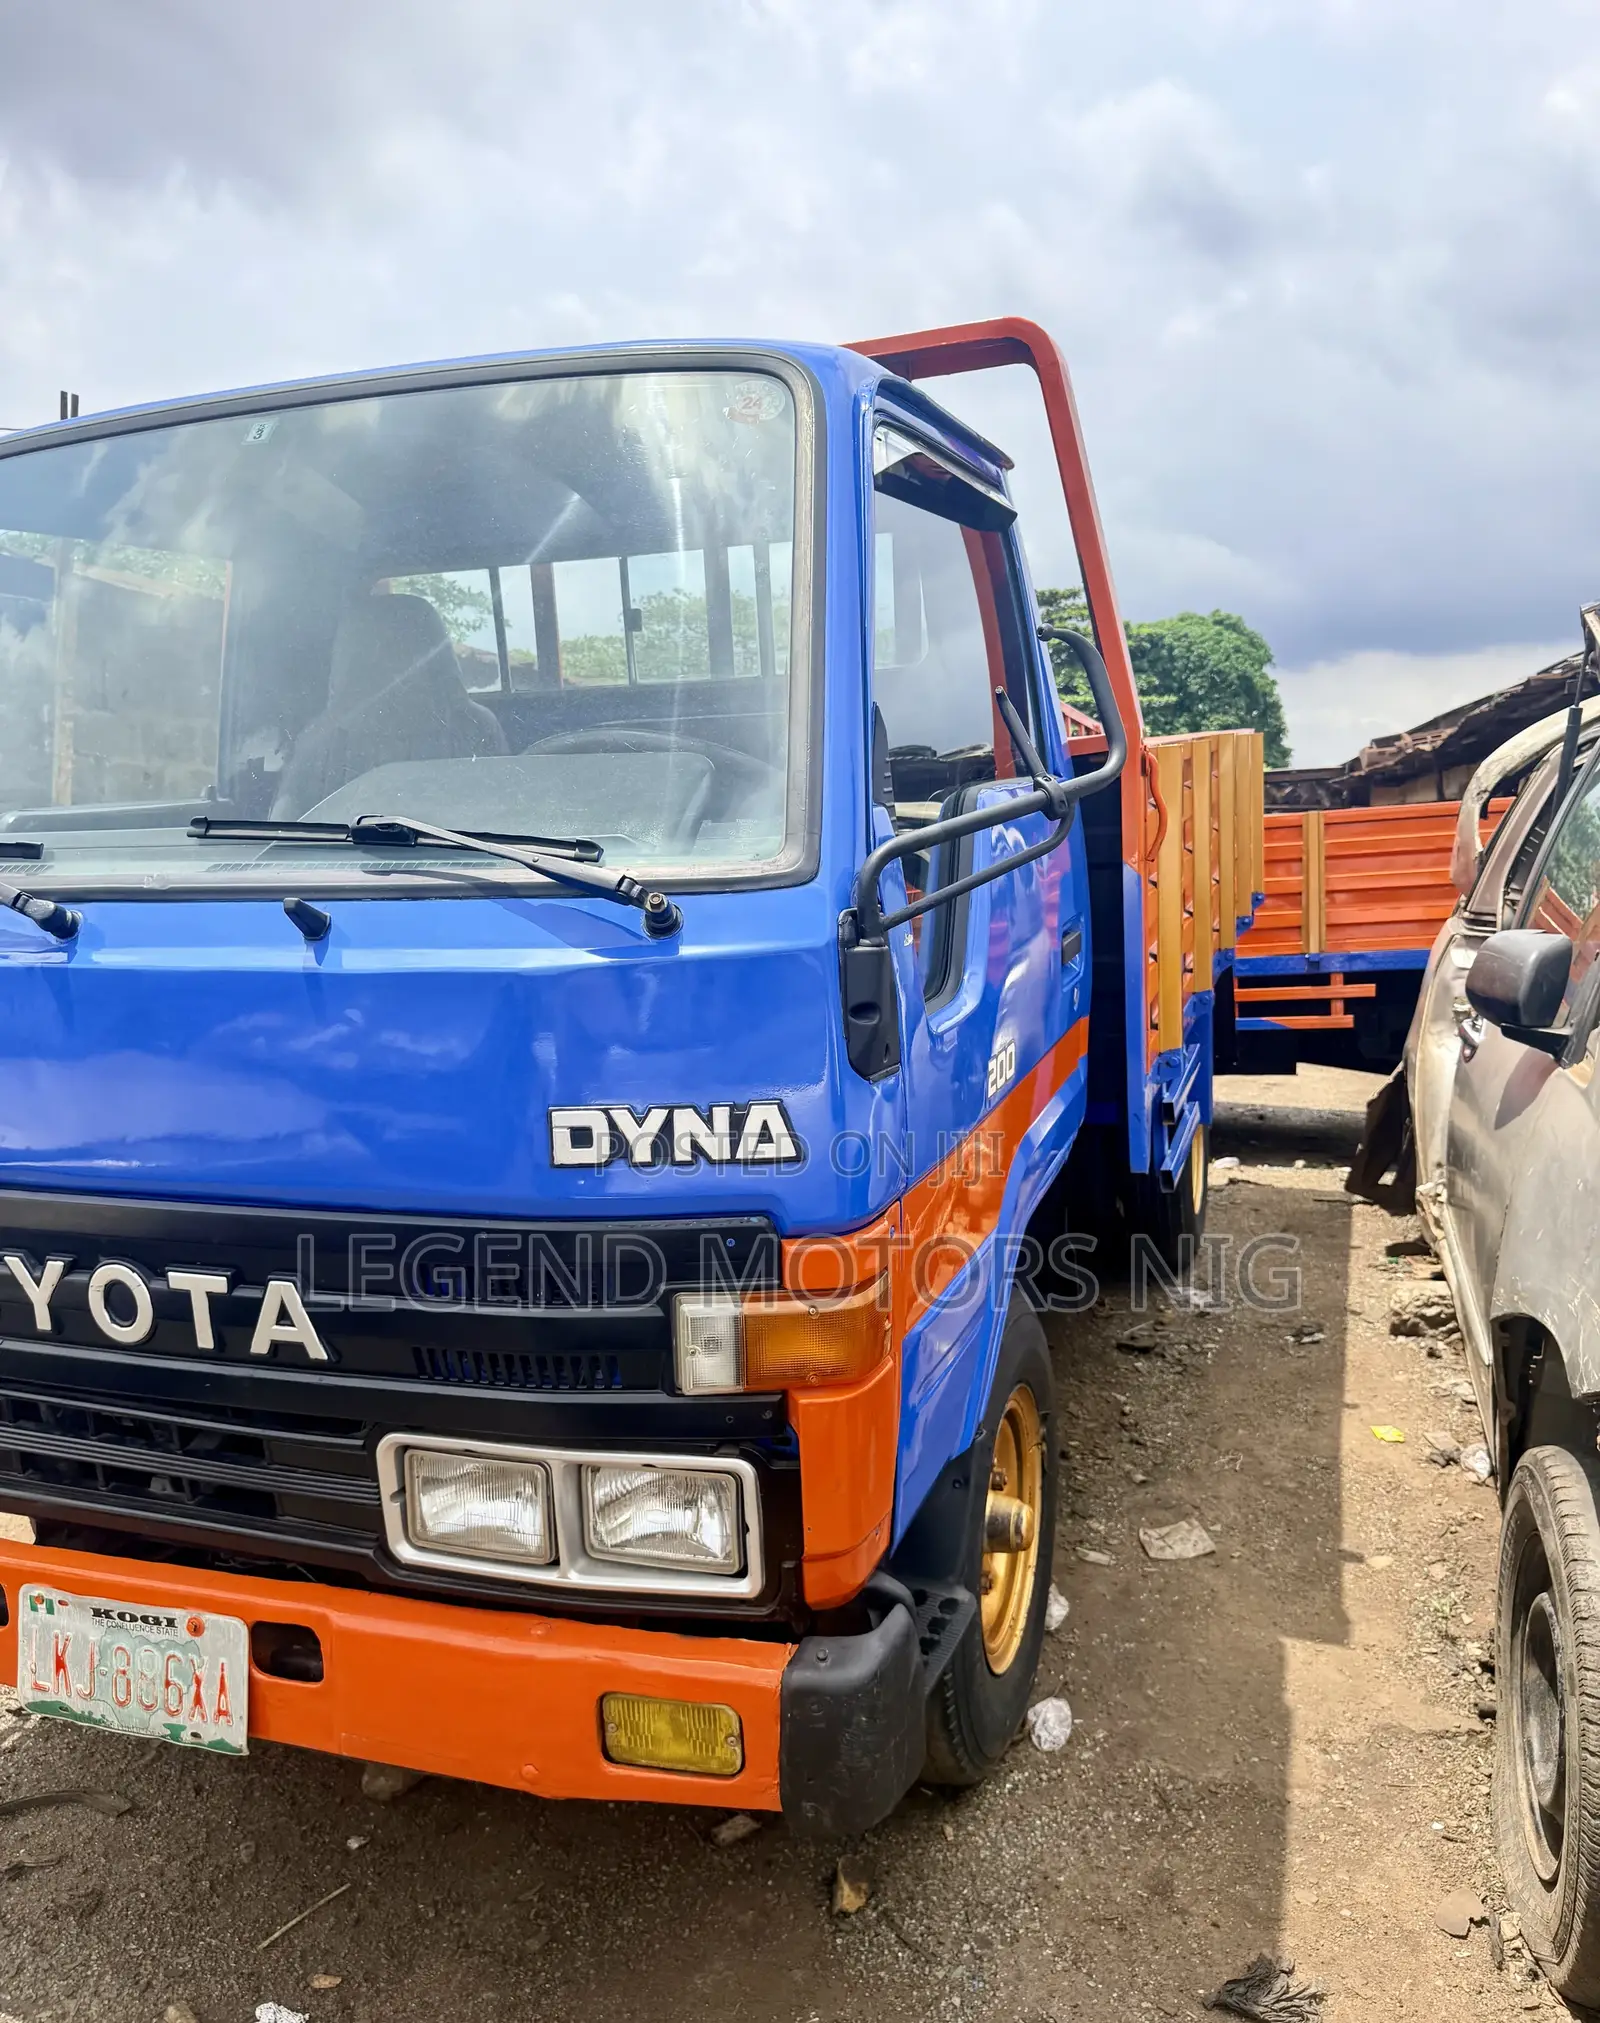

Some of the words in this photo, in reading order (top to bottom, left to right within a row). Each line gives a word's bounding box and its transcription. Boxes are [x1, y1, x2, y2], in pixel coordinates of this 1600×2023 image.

[987, 1041, 1016, 1099] 200
[549, 1100, 804, 1168] DYNA
[90, 1607, 178, 1628] KOGI
[92, 1617, 105, 1627] THE
[106, 1619, 155, 1634] CONFLUENCE
[156, 1626, 179, 1637] STATE
